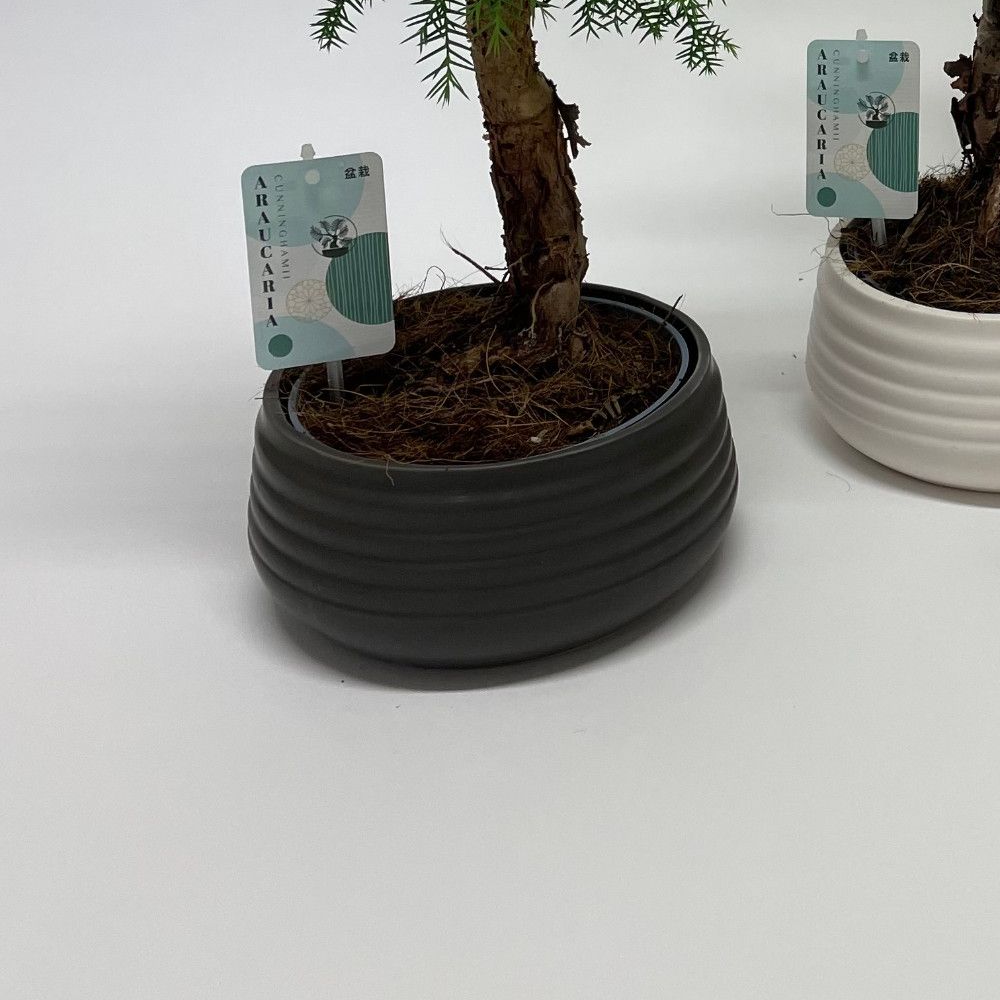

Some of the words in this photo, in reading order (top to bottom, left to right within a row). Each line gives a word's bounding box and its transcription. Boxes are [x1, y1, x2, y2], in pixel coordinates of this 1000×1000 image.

[888, 51, 910, 63] 盆栽
[816, 48, 828, 180] ARAUCARIA
[344, 165, 370, 180] 盆栽
[254, 175, 278, 328] ARAUCARIA
[274, 174, 291, 280] CUNNINGHAMII
